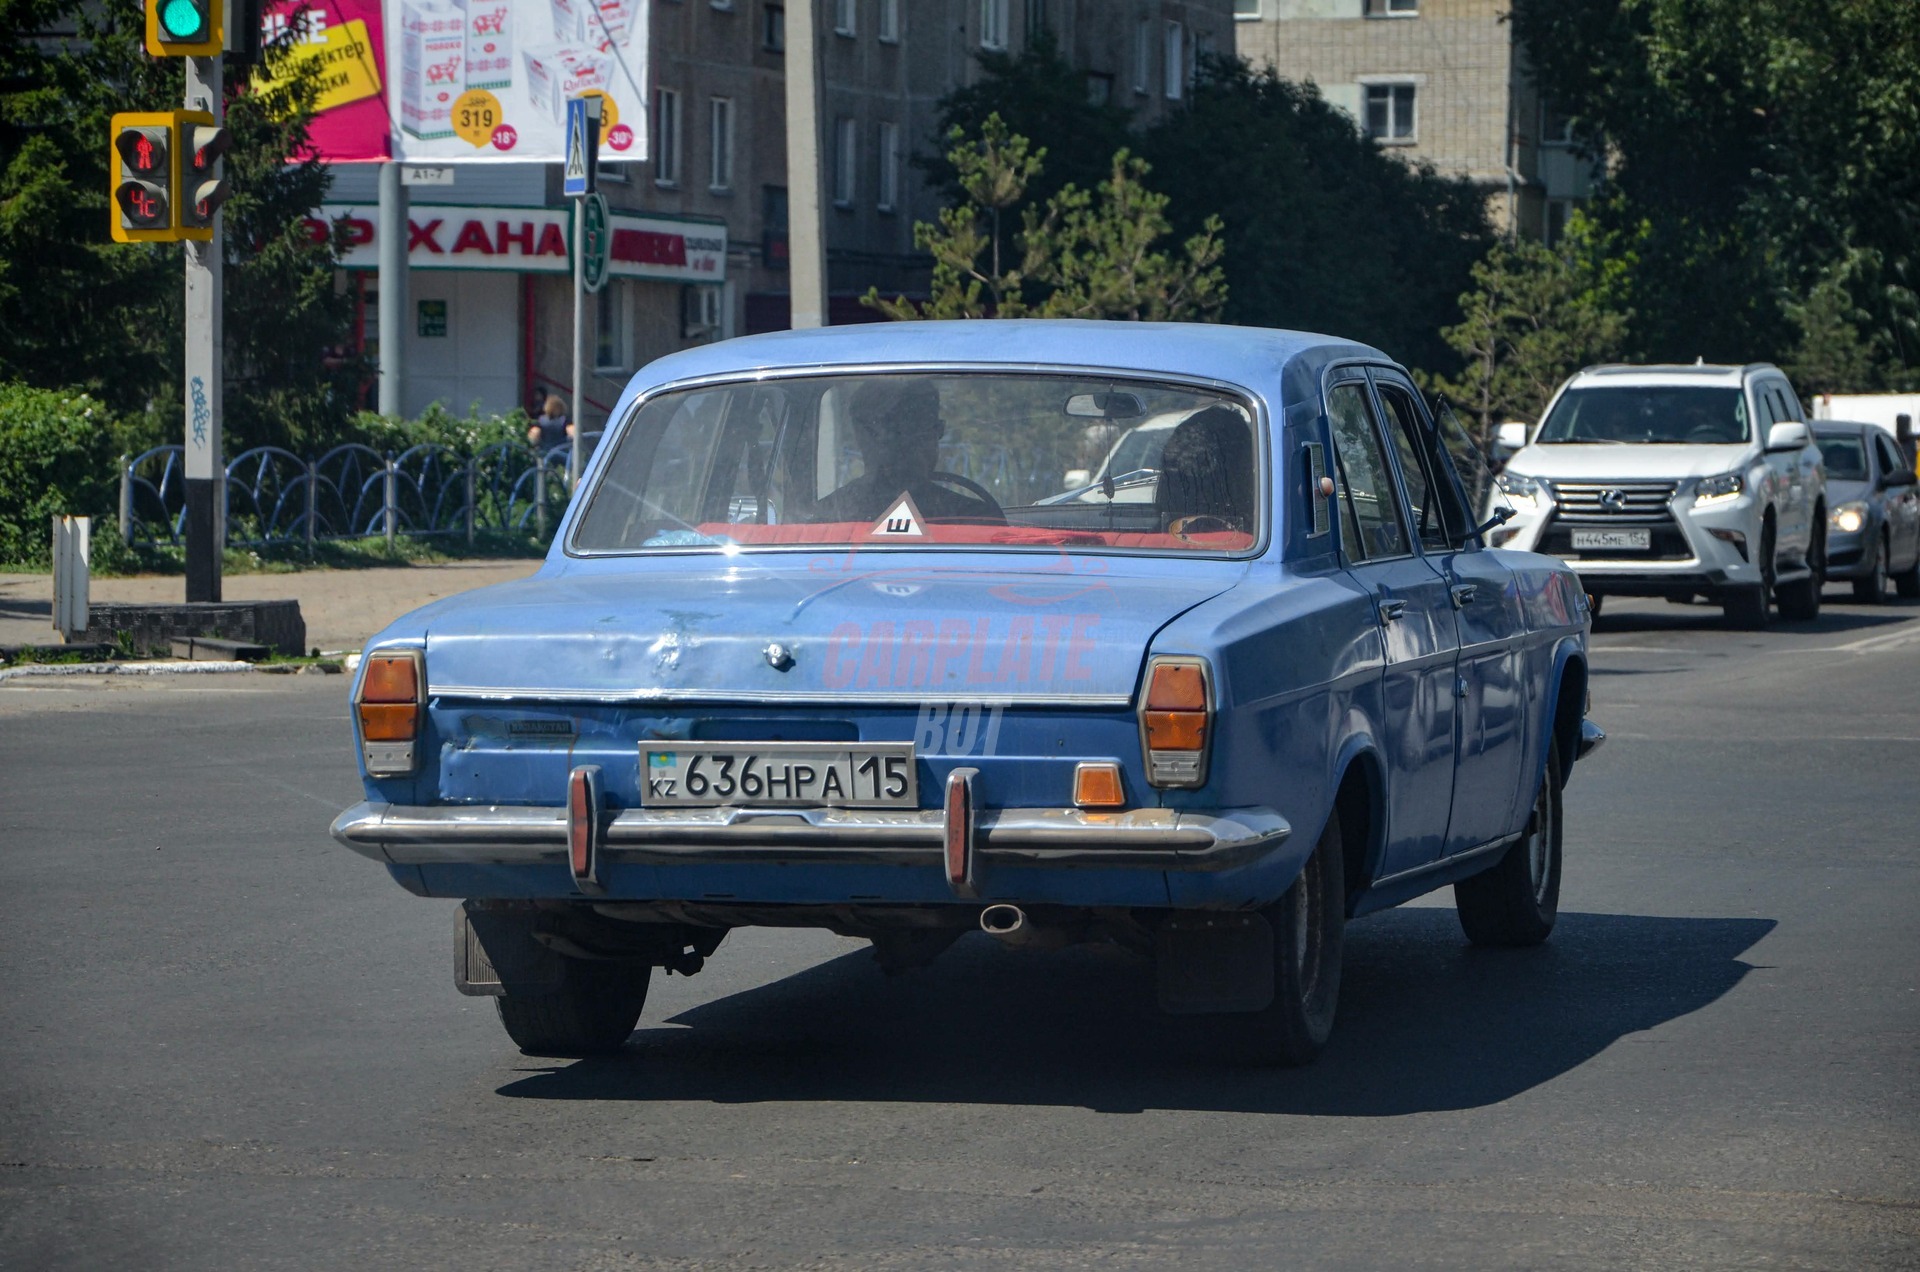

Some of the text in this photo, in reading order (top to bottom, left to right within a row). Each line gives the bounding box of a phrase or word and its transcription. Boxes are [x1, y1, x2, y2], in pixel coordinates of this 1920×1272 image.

[461, 109, 493, 128] 319
[886, 517, 911, 533] Ш
[650, 755, 908, 798] KZ 636HPA 15
